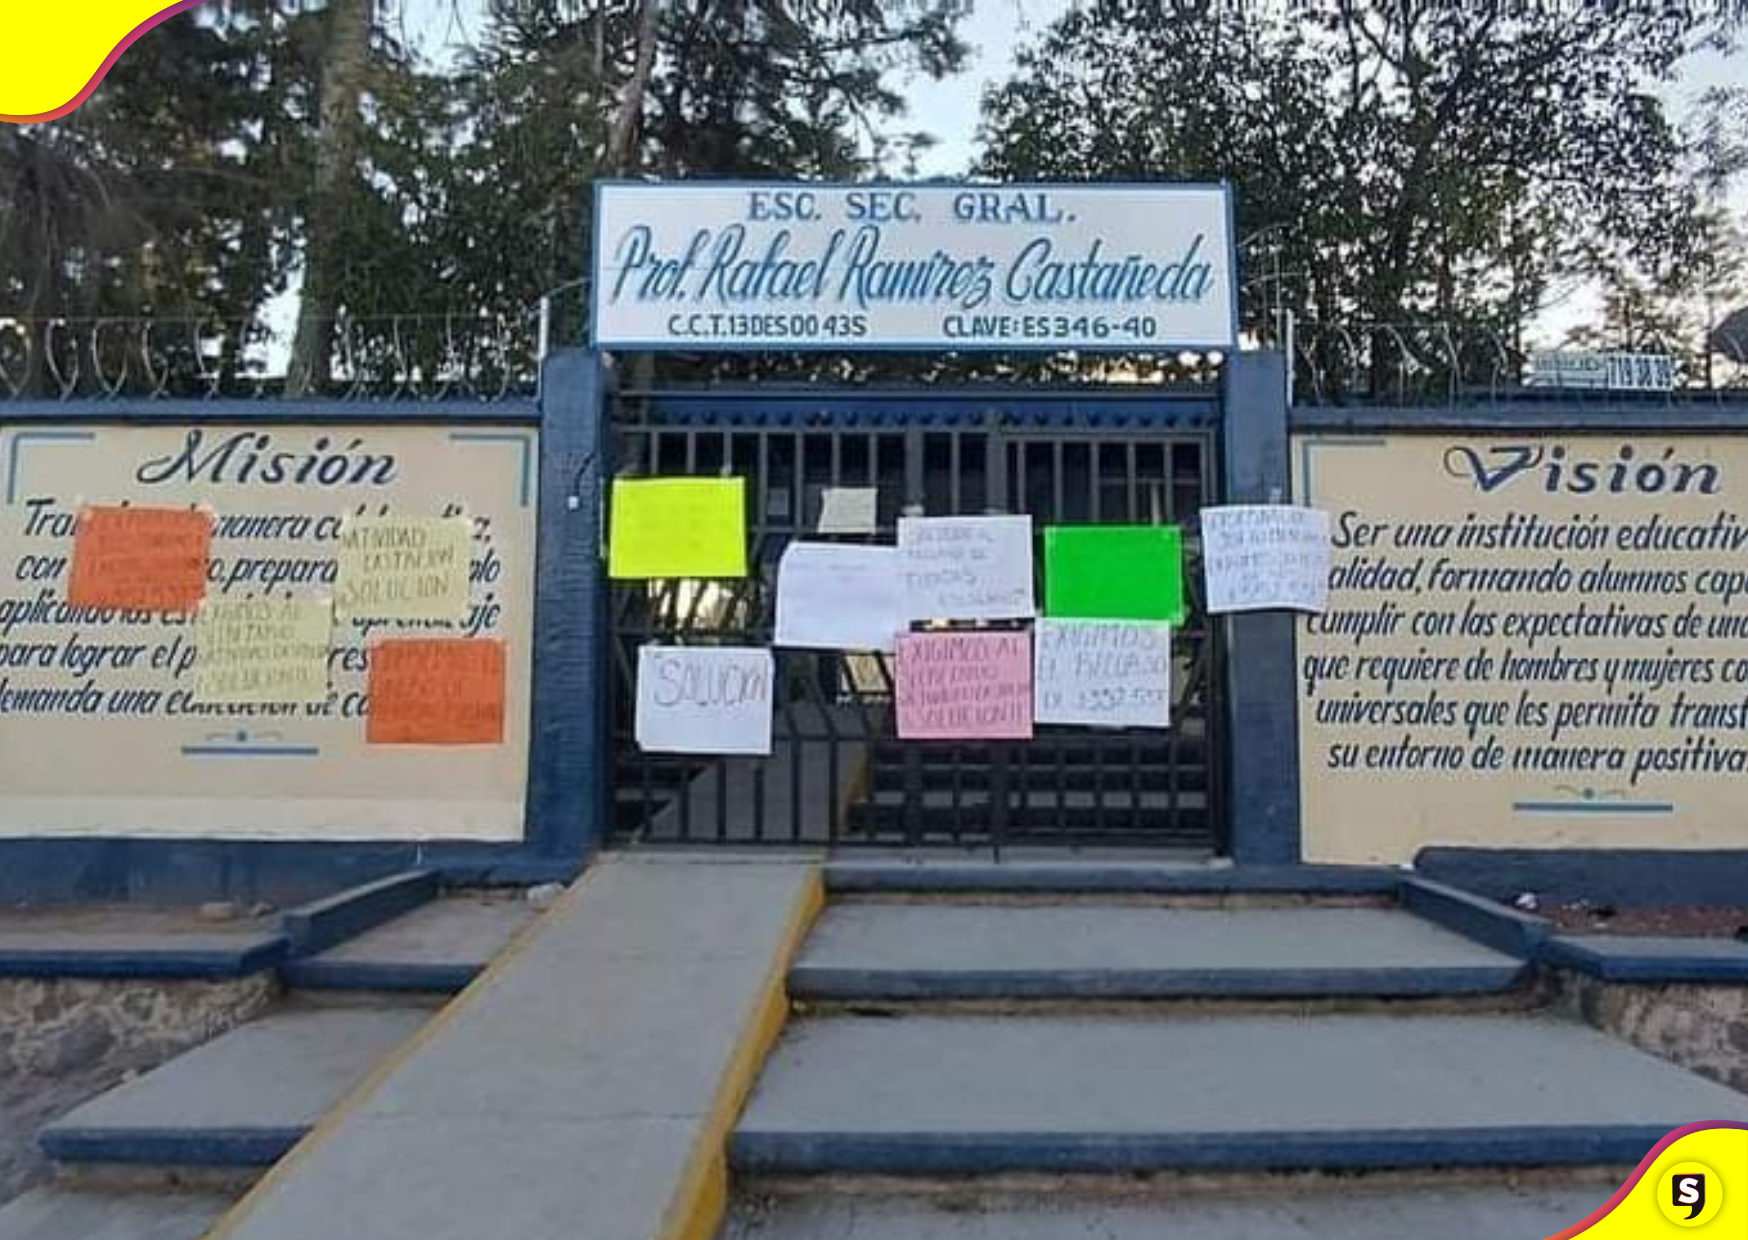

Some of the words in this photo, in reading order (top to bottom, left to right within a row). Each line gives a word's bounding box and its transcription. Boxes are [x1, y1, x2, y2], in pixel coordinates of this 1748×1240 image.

[747, 191, 822, 221] ESC.
[953, 192, 1076, 222] GRAL.
[612, 225, 710, 306] Prof.
[697, 223, 846, 308] Rafael
[1005, 233, 1214, 302] Castañeda
[136, 428, 397, 484] Misión
[1443, 444, 1719, 494] Visión
[1331, 511, 1388, 549] Ser
[1394, 523, 1450, 549] una
[1456, 512, 1608, 550] institución
[16, 555, 66, 580] con
[1328, 556, 1424, 595] alidad,
[1427, 558, 1572, 592] formando
[1578, 558, 1688, 593] alumnos
[1412, 611, 1456, 636] con
[1459, 599, 1498, 636] las
[1502, 602, 1668, 648] expectativas
[1673, 602, 1702, 639] de
[60, 633, 147, 677] lograr
[152, 635, 181, 668] el
[1304, 655, 1349, 696] que
[1354, 648, 1460, 694] requiere
[1465, 647, 1493, 681] de
[1501, 647, 1598, 682] hombres
[1603, 657, 1628, 696] y
[1629, 647, 1714, 690] mujeres
[109, 690, 162, 714] una
[1316, 689, 1457, 725] universales
[1464, 700, 1510, 741] que
[1515, 689, 1549, 727] les
[1551, 692, 1661, 742] permita
[1328, 743, 1360, 769] su
[1366, 733, 1465, 769] entorno
[1472, 734, 1505, 770] de
[1513, 746, 1627, 771] manera
